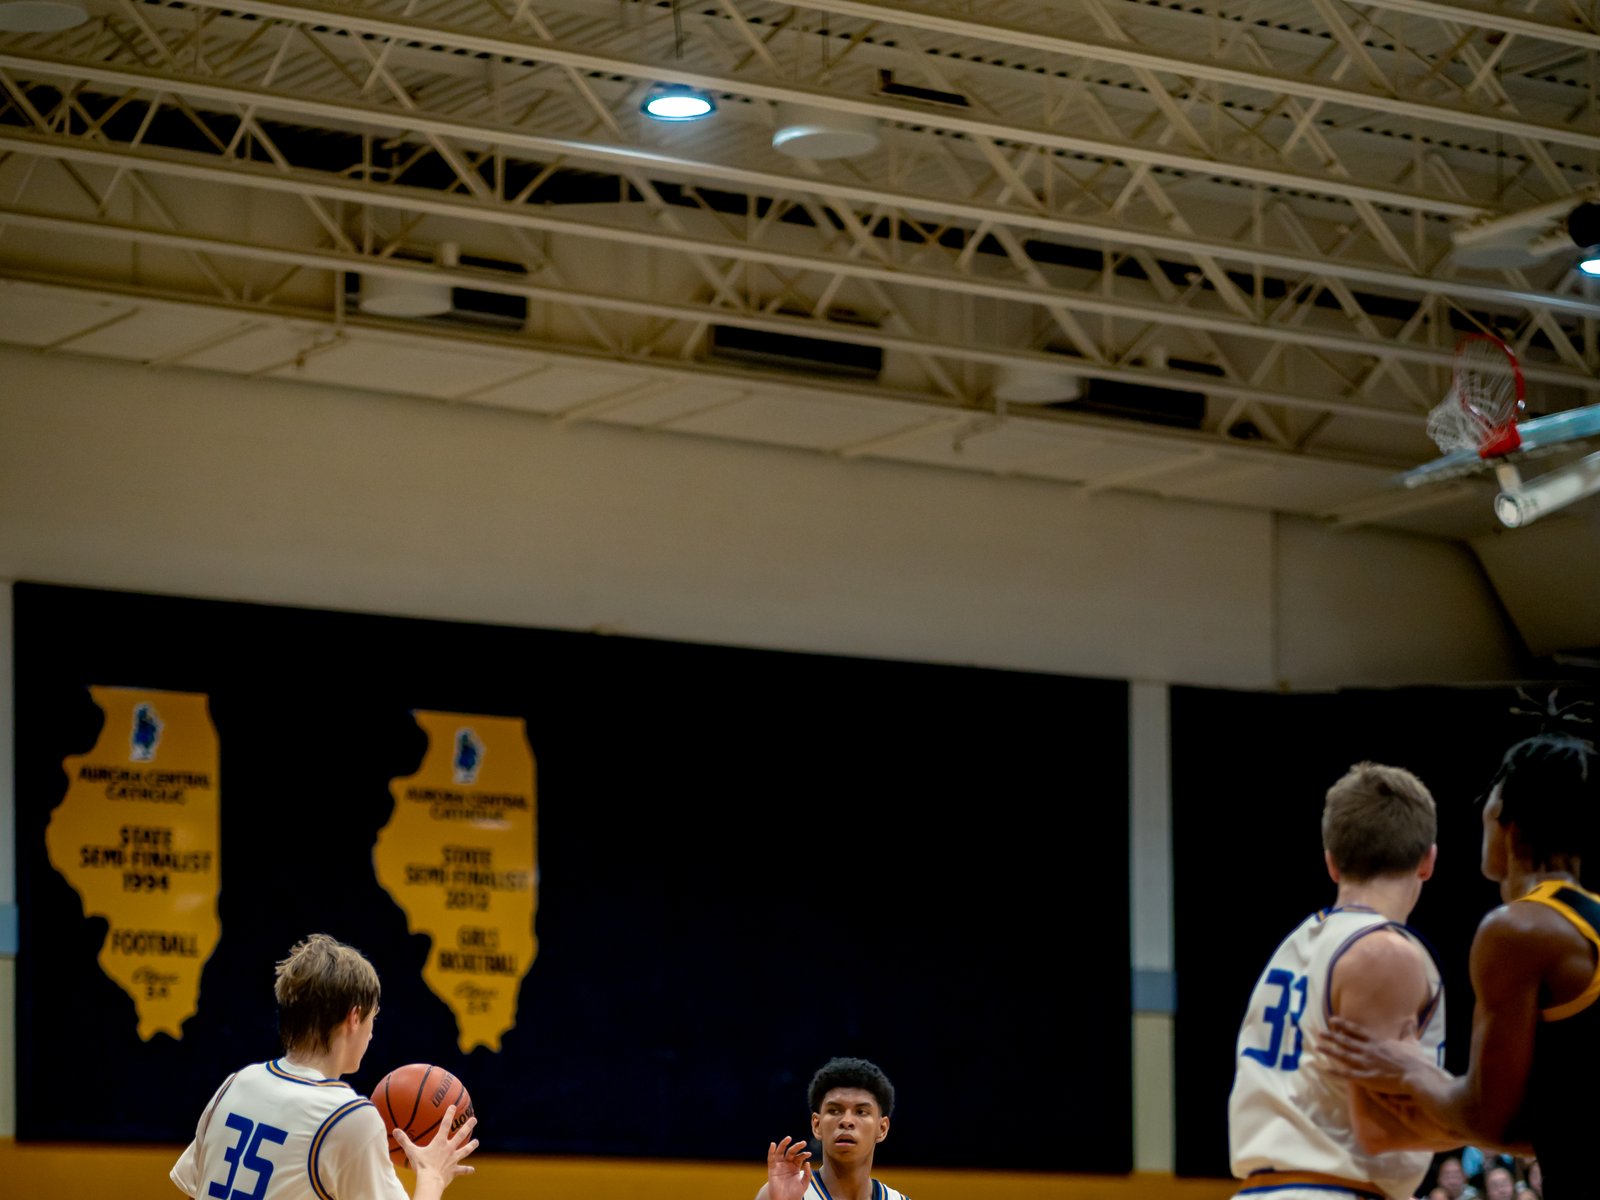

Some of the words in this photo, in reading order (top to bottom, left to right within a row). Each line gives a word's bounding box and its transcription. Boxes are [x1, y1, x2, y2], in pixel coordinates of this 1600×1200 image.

[121, 826, 171, 848] STATE
[442, 845, 492, 868] STATE
[122, 873, 169, 893] 1994
[112, 930, 198, 957] FOOTBALL
